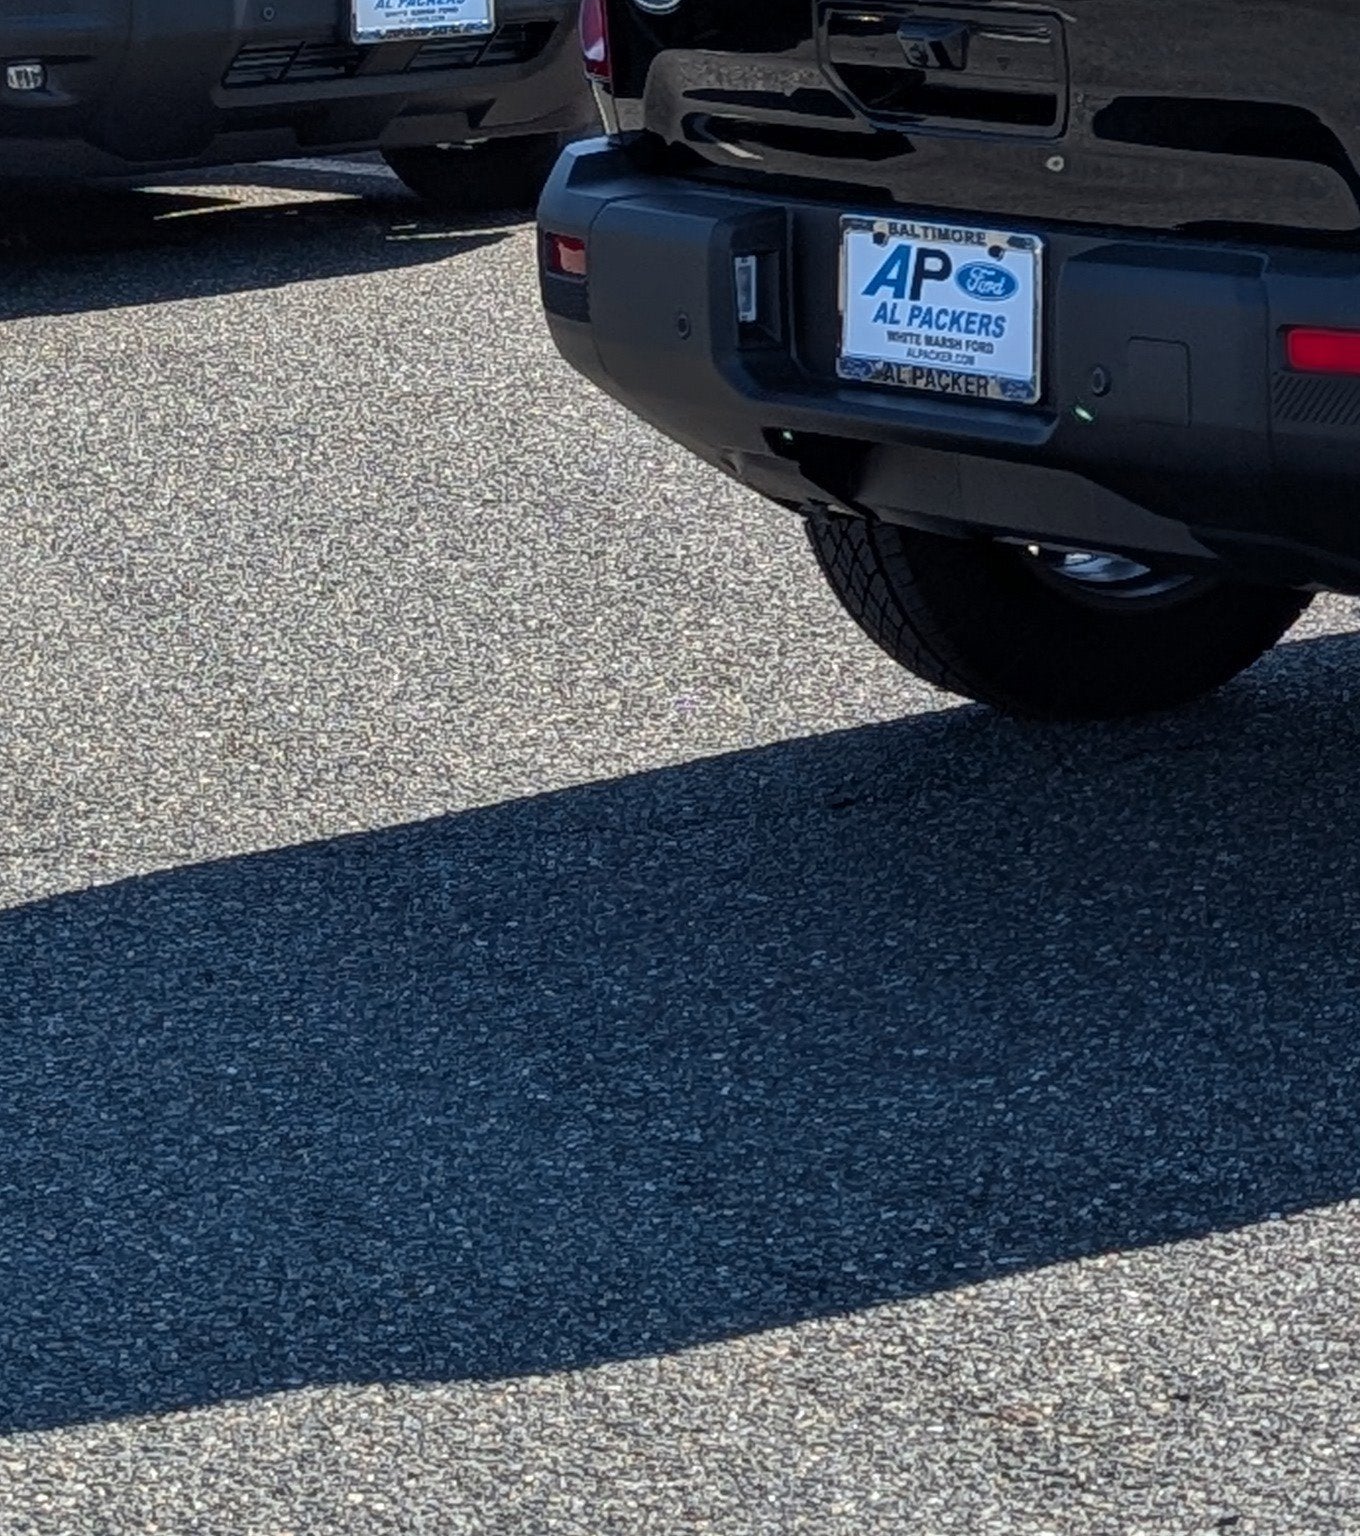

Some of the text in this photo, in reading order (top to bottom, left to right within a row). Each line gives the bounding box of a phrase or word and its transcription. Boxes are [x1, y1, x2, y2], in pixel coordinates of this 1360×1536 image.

[888, 222, 987, 247] BALTIMORE
[861, 243, 1007, 302] AP Ford
[872, 300, 1008, 339] AL PACKERS
[886, 330, 994, 355] WHITE MARSH FORD
[883, 362, 906, 384] AL
[911, 365, 990, 397] PACKER
